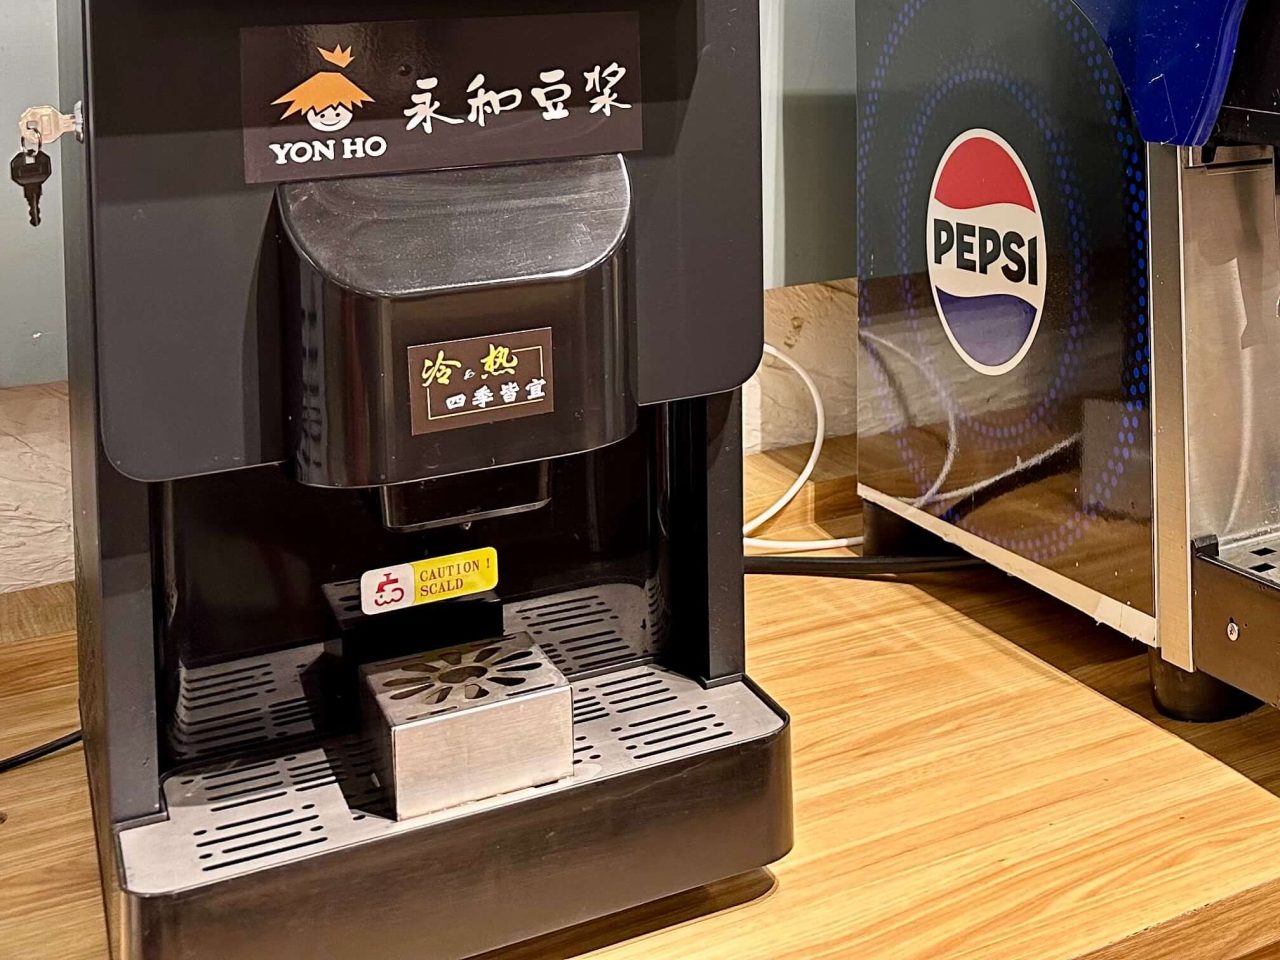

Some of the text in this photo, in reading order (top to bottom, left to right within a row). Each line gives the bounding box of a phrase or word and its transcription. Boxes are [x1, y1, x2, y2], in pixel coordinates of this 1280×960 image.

[268, 135, 387, 165] YON HO
[933, 218, 1038, 286] PEPSI
[445, 378, 546, 410] 四季皆宜
[419, 559, 480, 583] CAUTION
[420, 577, 464, 597] SCALD
